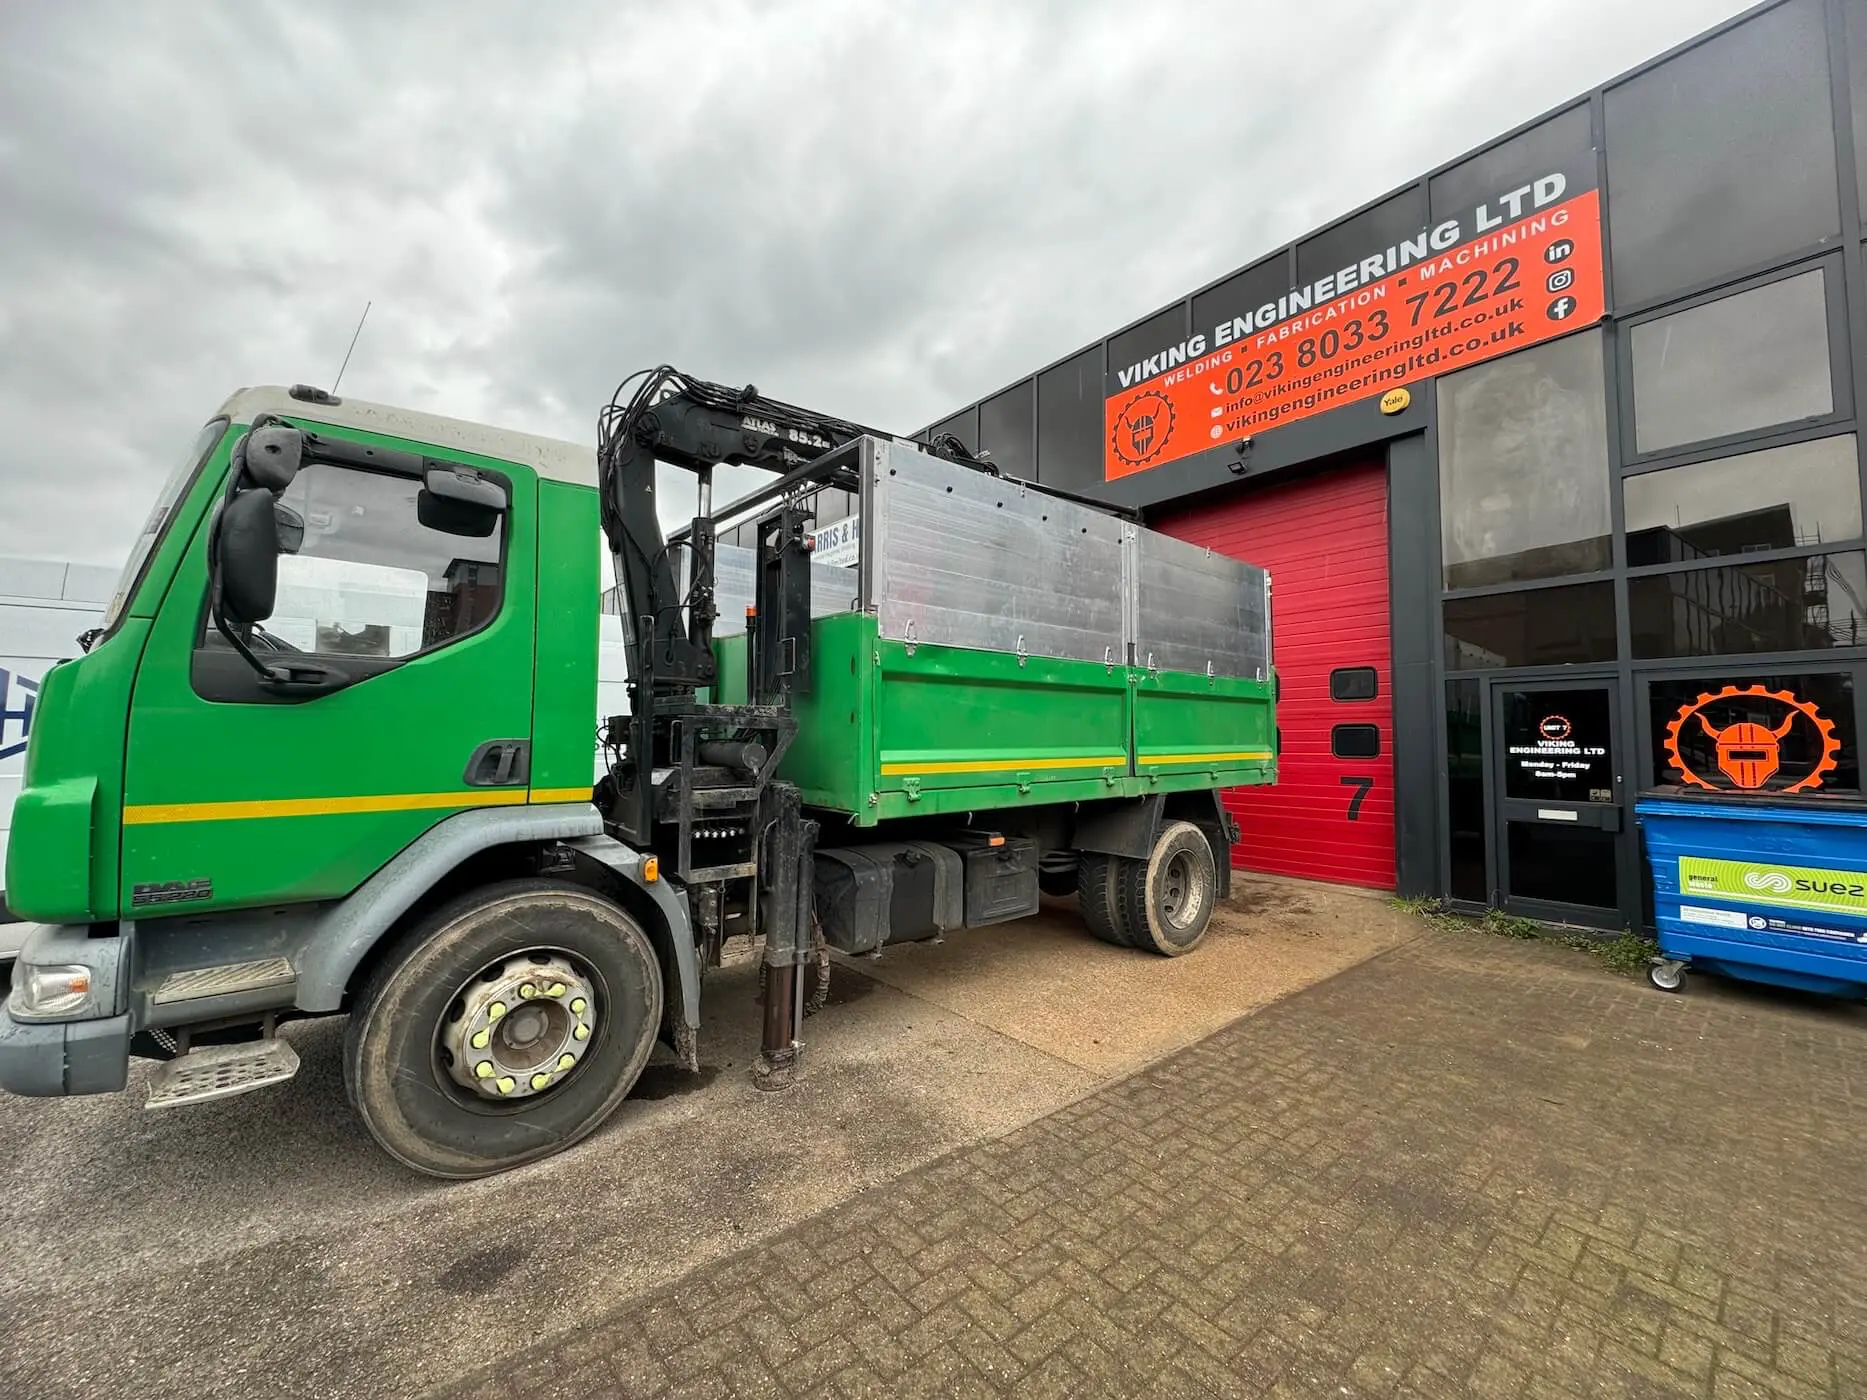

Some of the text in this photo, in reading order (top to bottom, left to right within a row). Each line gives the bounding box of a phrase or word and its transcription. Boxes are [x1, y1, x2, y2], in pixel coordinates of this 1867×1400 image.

[1118, 173, 1566, 388] VIKING ENGINEERING LTD
[1164, 209, 1569, 387] WELDING FABRICATION MACHINING
[1226, 257, 1520, 394] 023 8033 7222
[1226, 298, 1524, 414] info@vikingengineeringltd.co.uk
[1225, 321, 1525, 432] vikingengineeringltd.co.uk
[1384, 396, 1403, 406] Yale
[742, 415, 777, 433] ATLAS
[814, 527, 839, 553] RRIS
[841, 523, 849, 544] &
[1509, 747, 1581, 755] ENGINEERING
[1537, 740, 1576, 748] VIKING
[1521, 761, 1555, 769] Monday
[1562, 762, 1591, 770] Friday
[1340, 777, 1374, 821] 7
[1688, 874, 1718, 882] general
[1796, 879, 1865, 897] suez
